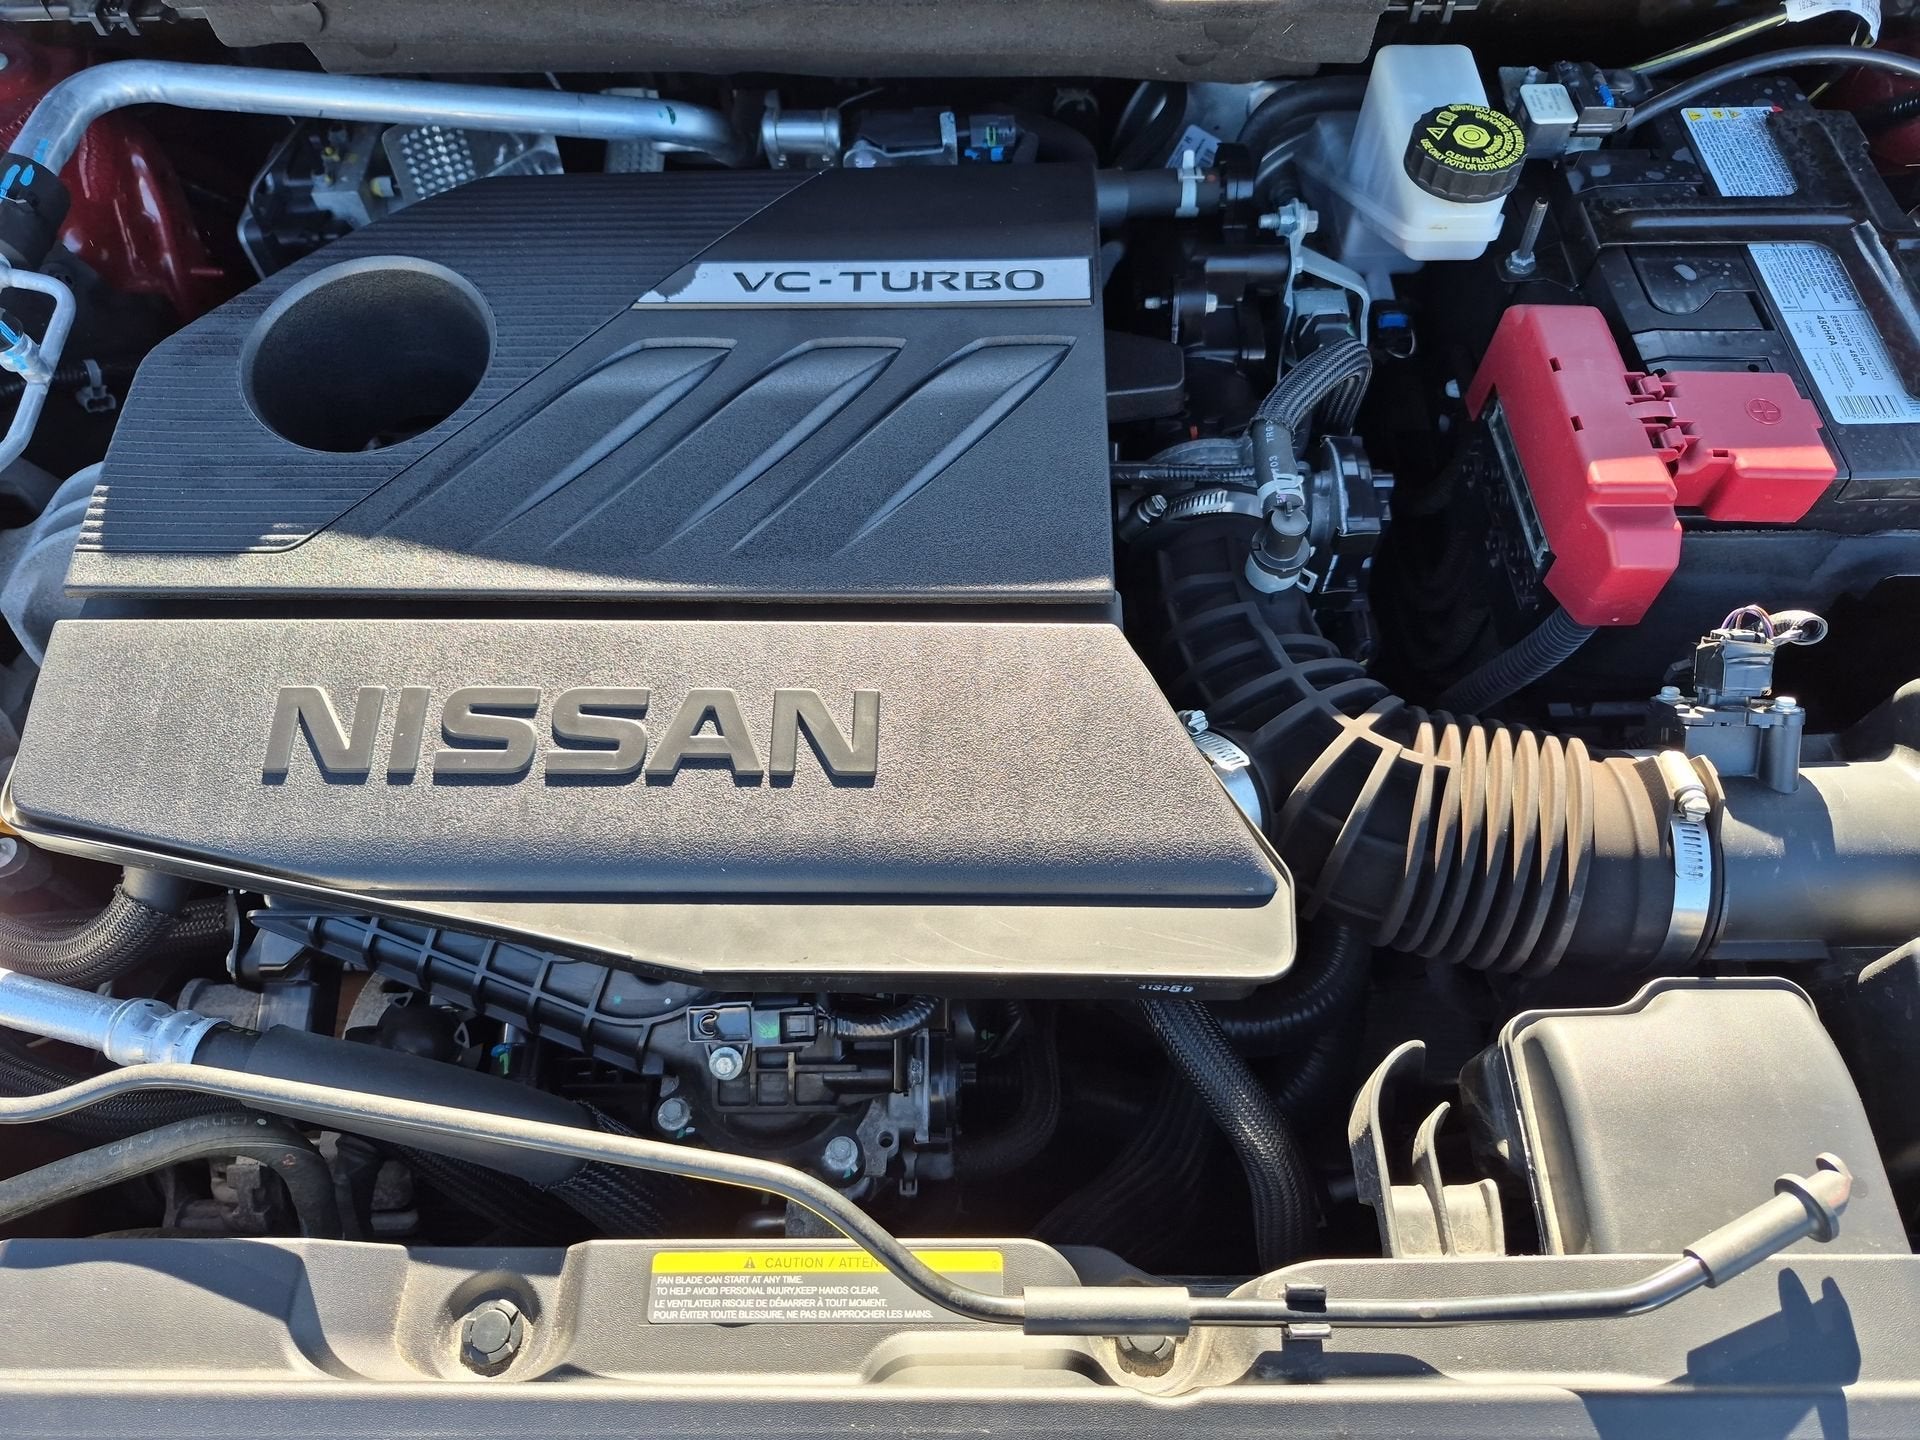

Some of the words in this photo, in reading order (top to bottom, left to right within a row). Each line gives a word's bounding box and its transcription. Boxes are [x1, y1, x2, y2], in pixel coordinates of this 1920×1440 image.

[1448, 104, 1490, 114] CONTAINER
[1475, 112, 1510, 132] REMOVING
[1490, 110, 1515, 127] SEALED
[1420, 138, 1431, 150] USE
[1428, 146, 1447, 160] ONLY
[1445, 150, 1470, 163] CLEAN
[1471, 154, 1497, 164] FILLER
[1494, 149, 1508, 160] CAP
[1444, 157, 1465, 169] DOT3
[1464, 163, 1477, 171] OR
[1477, 163, 1497, 171] DOT4
[1495, 154, 1519, 168] BRAKE
[733, 270, 1044, 293] VC-TURBO
[1817, 315, 1838, 346] 48GHRA
[1849, 349, 1867, 376] 48GHRA
[262, 686, 881, 777] NISSAN
[765, 1257, 824, 1268] CAUTION
[656, 1275, 674, 1284] FAN
[675, 1275, 703, 1284] BLADE
[704, 1275, 722, 1284] CAN
[724, 1275, 749, 1284] START
[751, 1275, 762, 1284] AT
[763, 1275, 781, 1284] ANY
[783, 1275, 803, 1284] TIME.
[656, 1287, 668, 1295] TO
[669, 1287, 692, 1295] HELP
[692, 1287, 718, 1295] AVOID
[720, 1287, 766, 1295] PERSONAL
[818, 1286, 849, 1295] HANDS
[850, 1286, 880, 1295] CLEAR.
[654, 1299, 665, 1308] LE
[666, 1299, 721, 1308] VENTILATEUR
[722, 1299, 755, 1308] RISQUE
[756, 1299, 768, 1308] DE
[769, 1297, 815, 1307] DÉMARRER
[816, 1297, 824, 1307] À
[825, 1298, 847, 1307] TOUT
[848, 1298, 888, 1307] MOMENT.
[653, 1310, 679, 1319] POUR
[680, 1308, 708, 1319] ÉVITER
[710, 1310, 737, 1319] TOUTE
[738, 1310, 785, 1319] BLESSURE,
[786, 1310, 798, 1319] NE
[800, 1310, 817, 1319] PAS
[818, 1310, 831, 1319] EN
[831, 1310, 886, 1319] APPROCHER
[886, 1310, 903, 1319] LES
[904, 1310, 933, 1319] MAINS.
